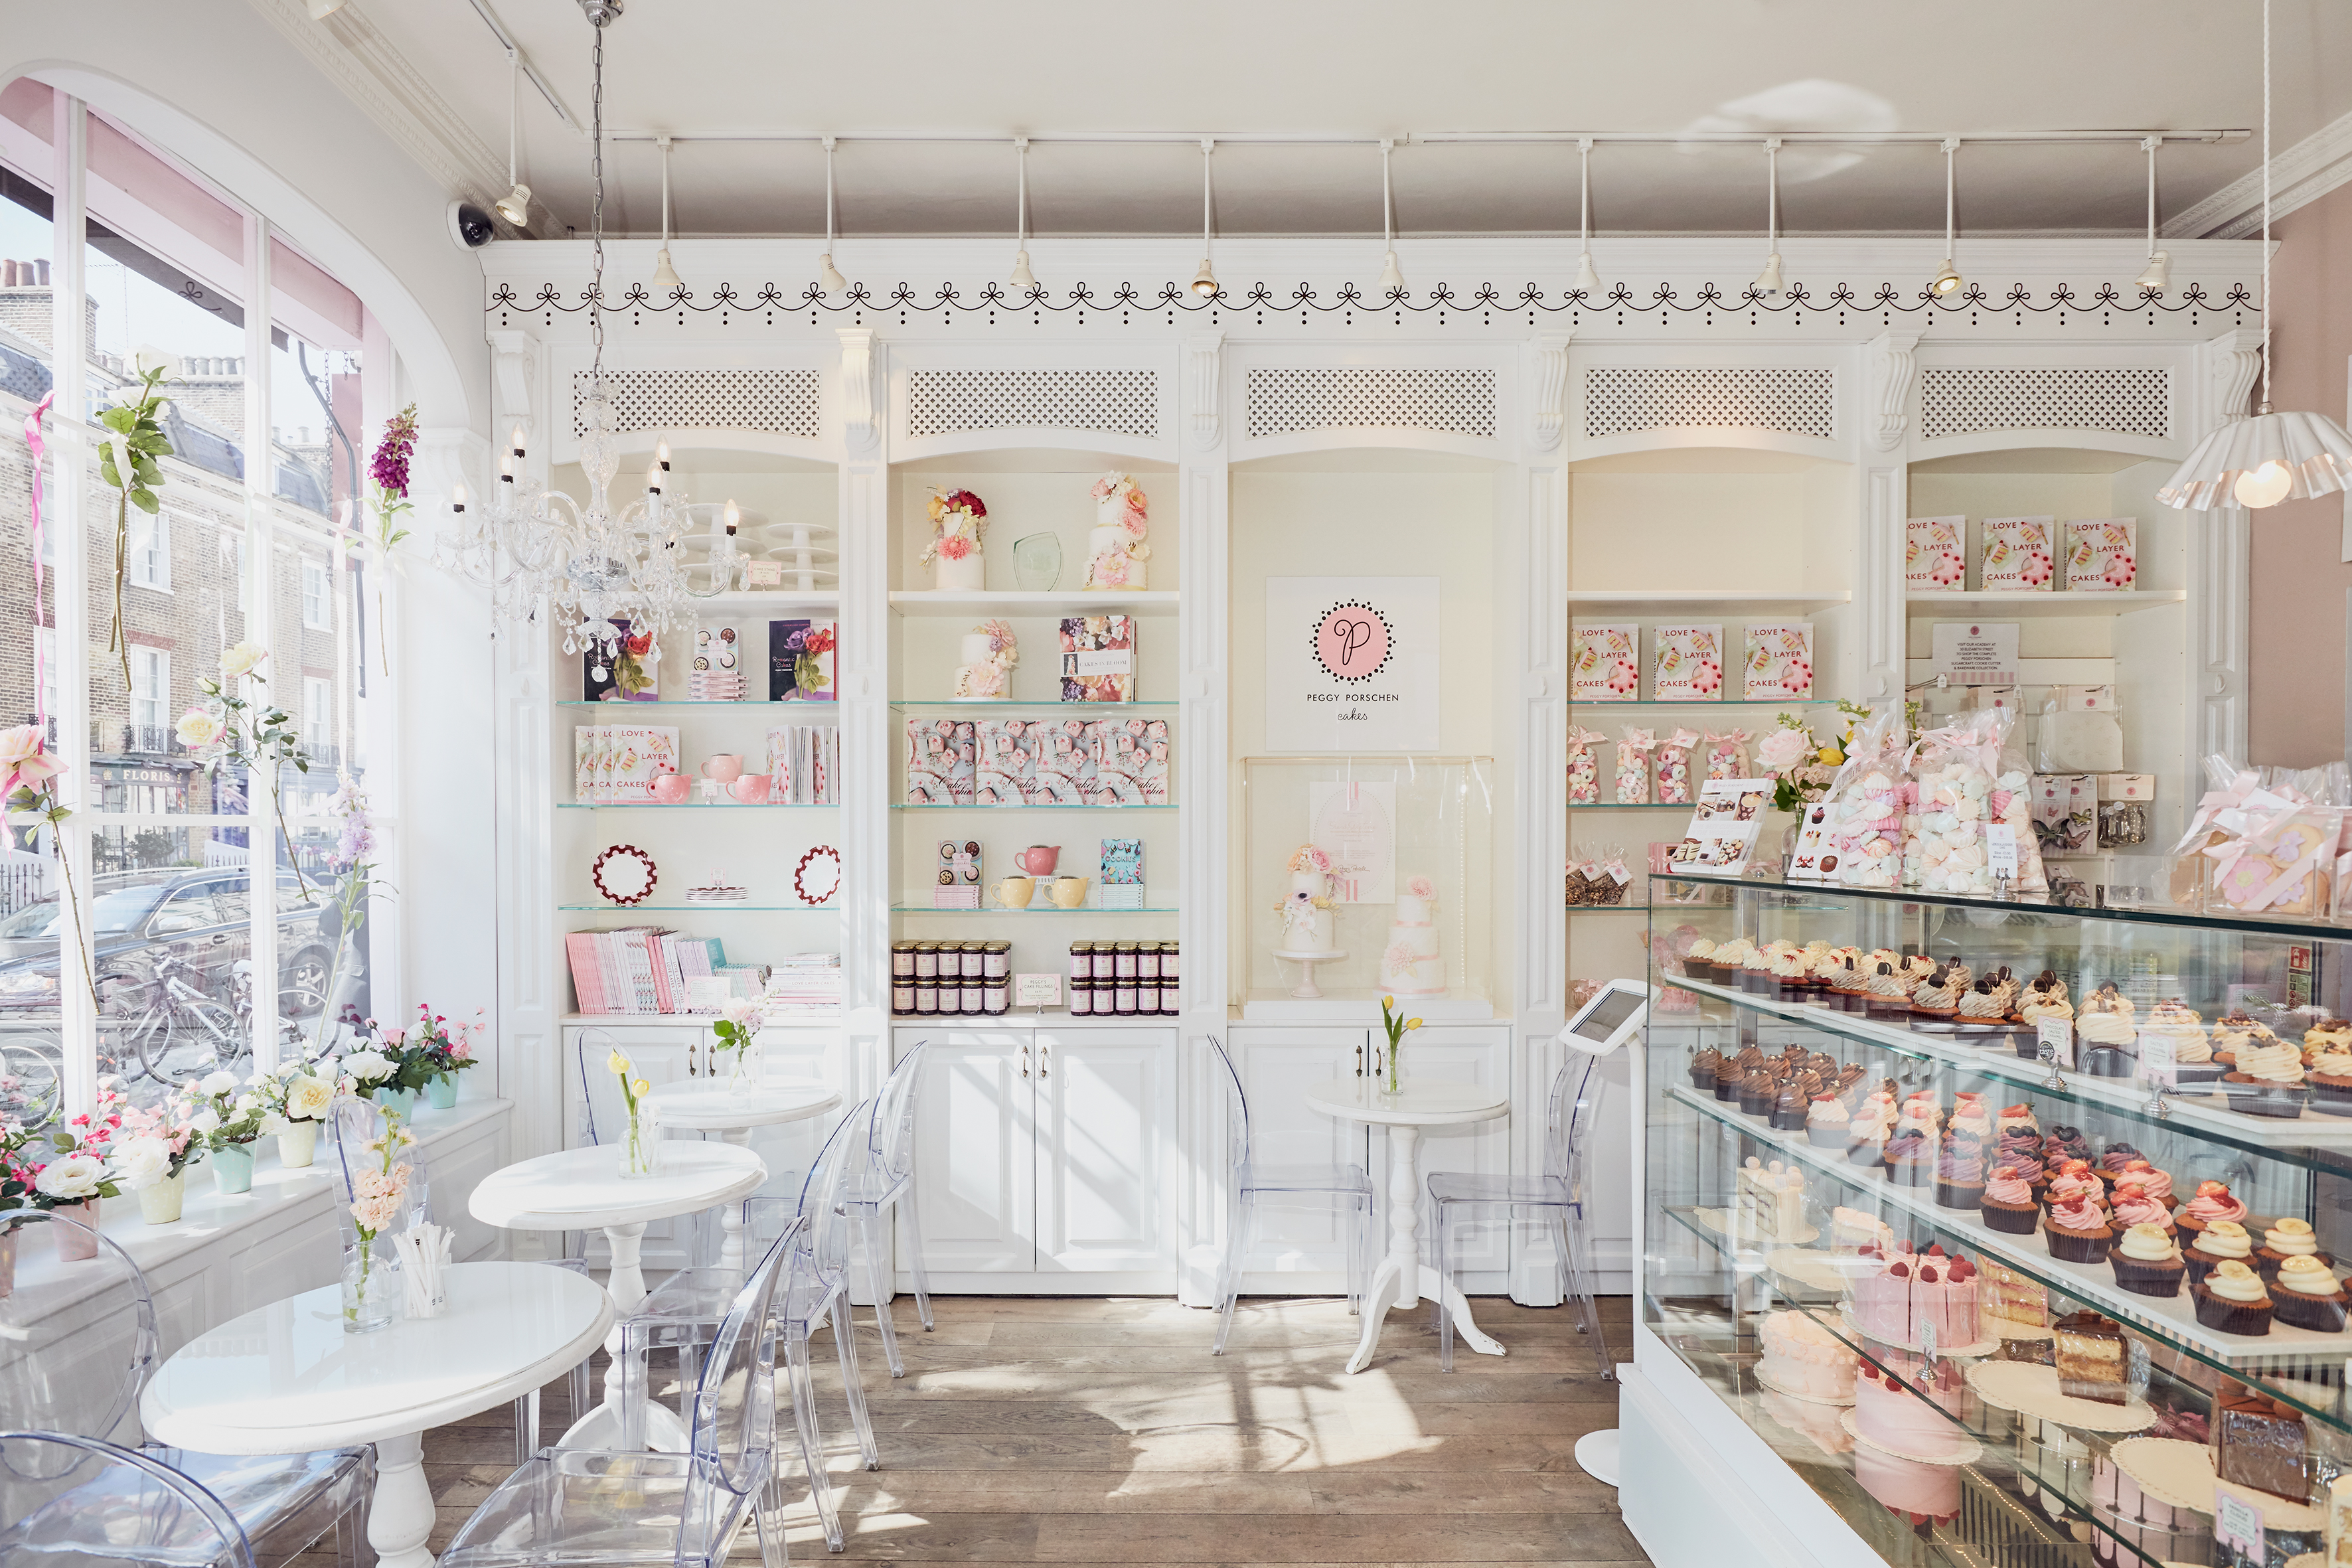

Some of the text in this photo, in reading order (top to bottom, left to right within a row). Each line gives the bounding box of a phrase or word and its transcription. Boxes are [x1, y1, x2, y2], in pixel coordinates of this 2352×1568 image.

[1337, 707, 1368, 721] cakes
[933, 773, 963, 789] Cake
[1002, 773, 1032, 789] Cake
[1061, 773, 1091, 789] Cake
[1123, 773, 1154, 789] Cake
[955, 783, 973, 795] chic
[1025, 785, 1036, 795] ch
[1083, 784, 1098, 795] chi
[1146, 783, 1164, 795] chic
